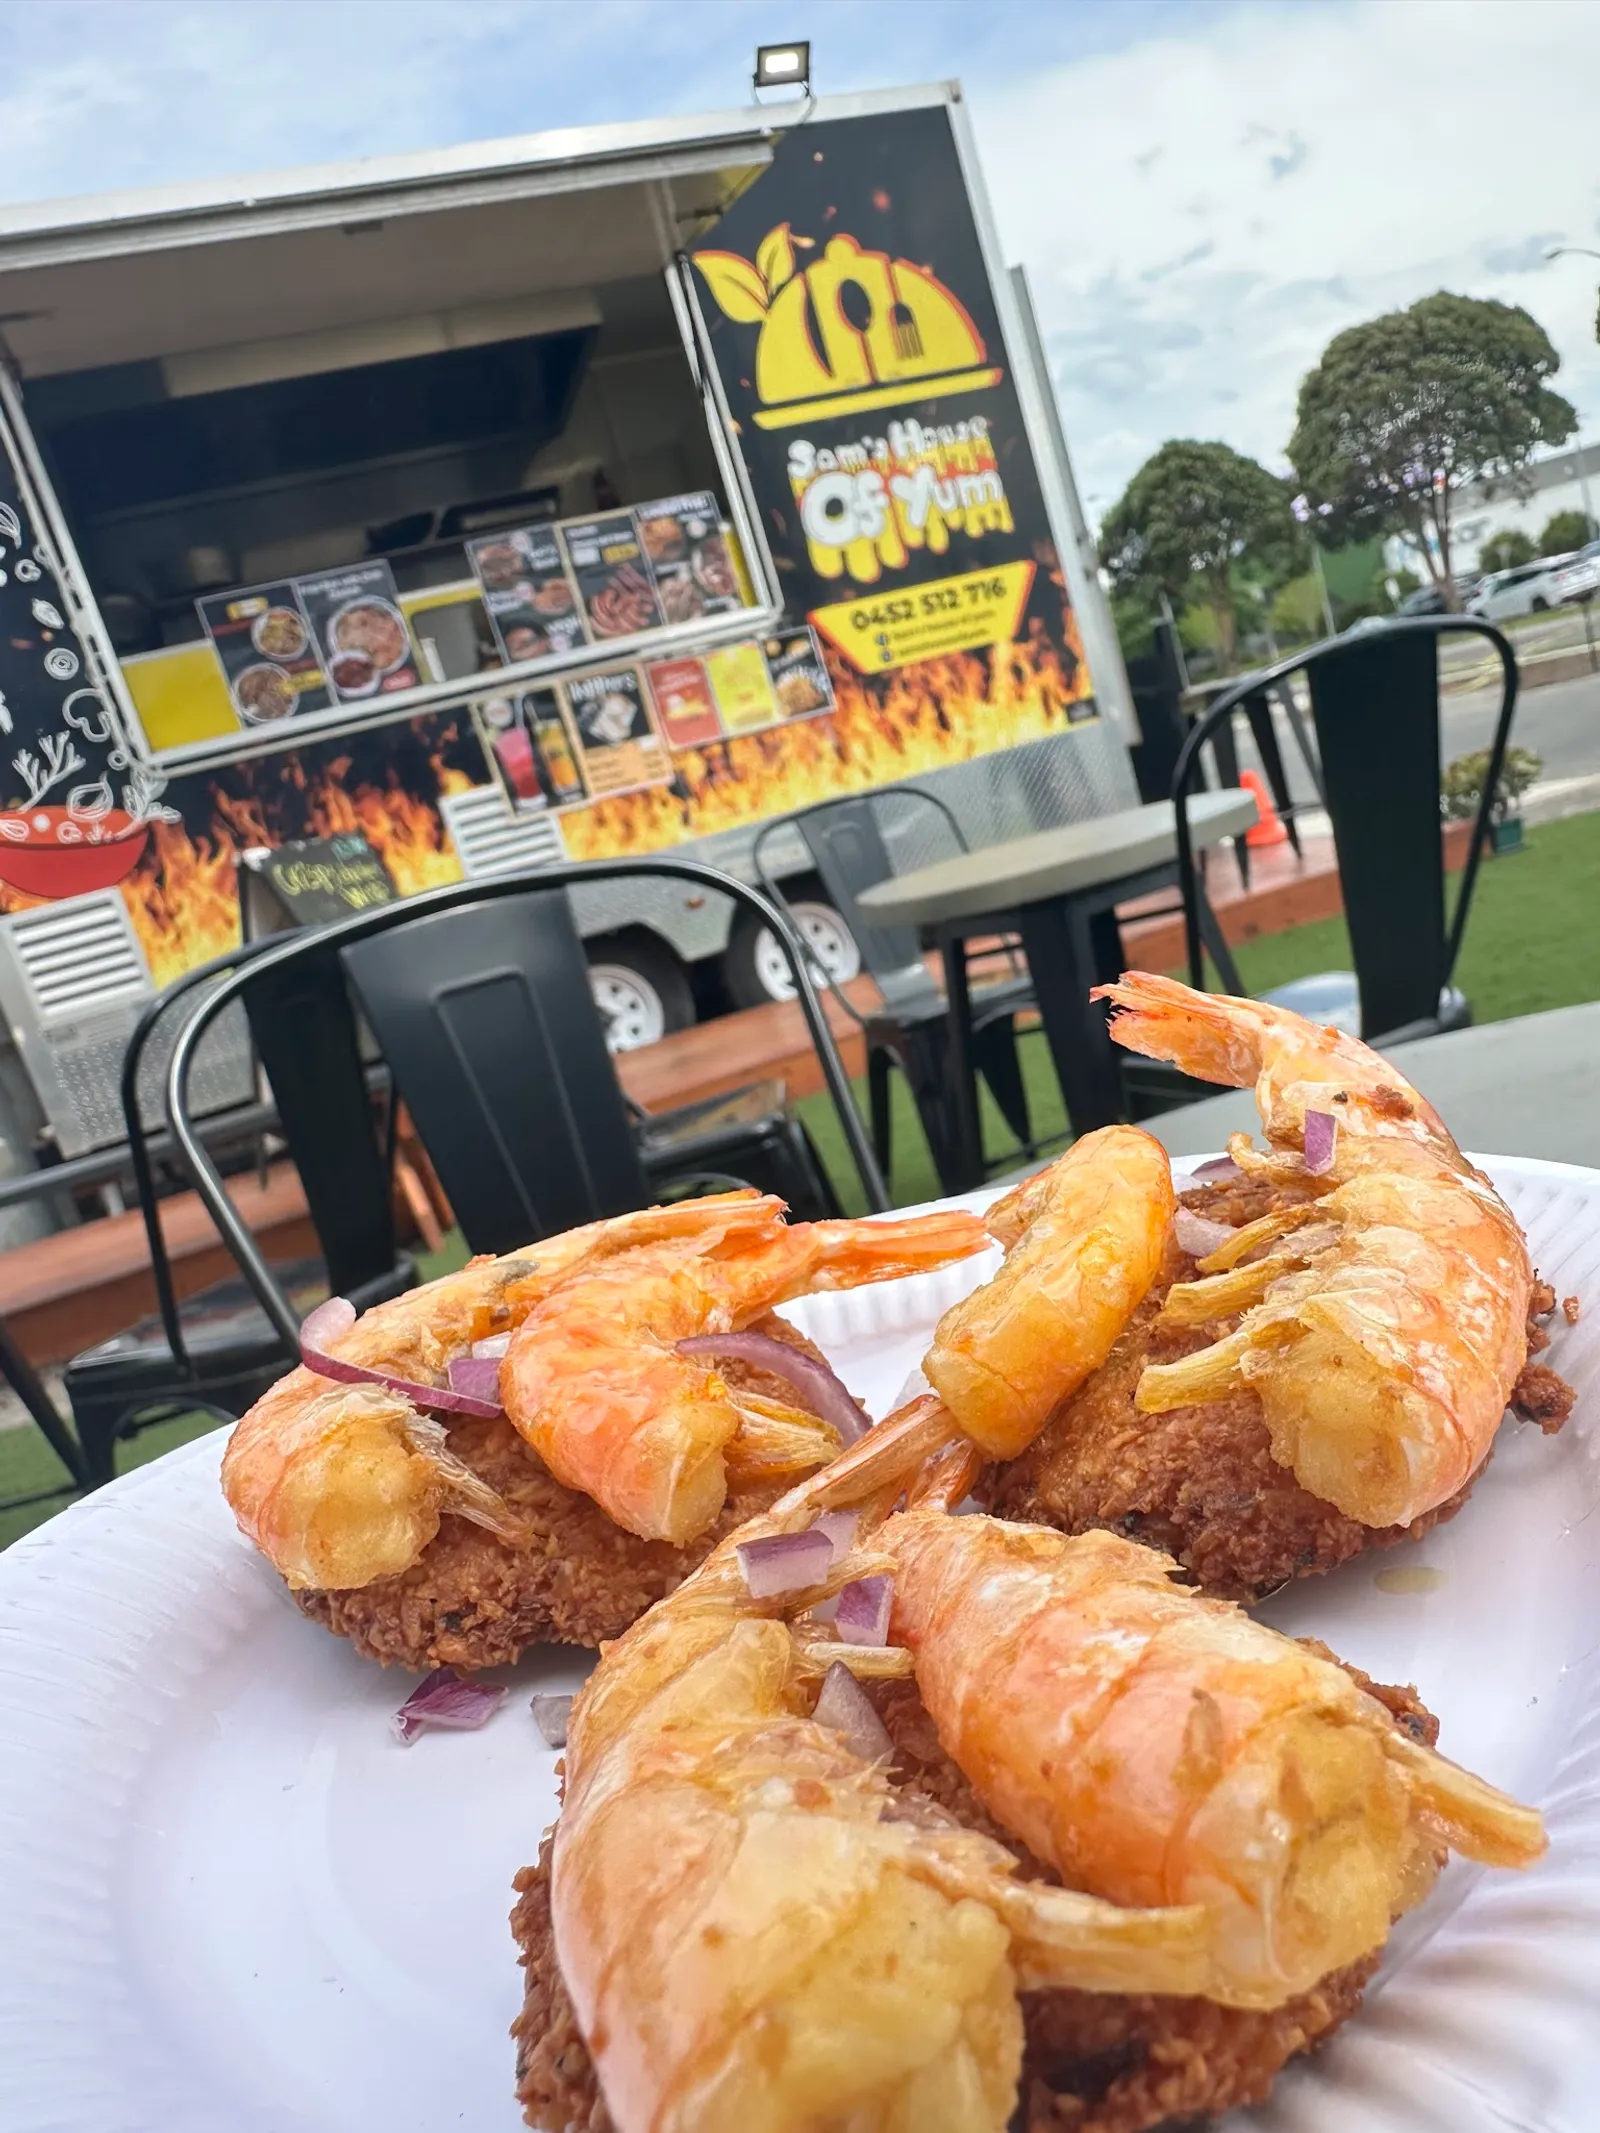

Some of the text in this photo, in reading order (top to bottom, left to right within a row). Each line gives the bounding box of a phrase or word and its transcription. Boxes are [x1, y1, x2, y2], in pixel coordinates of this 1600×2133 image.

[787, 416, 989, 479] Sam's House
[889, 464, 1004, 529] Yum
[851, 599, 914, 631] 0452
